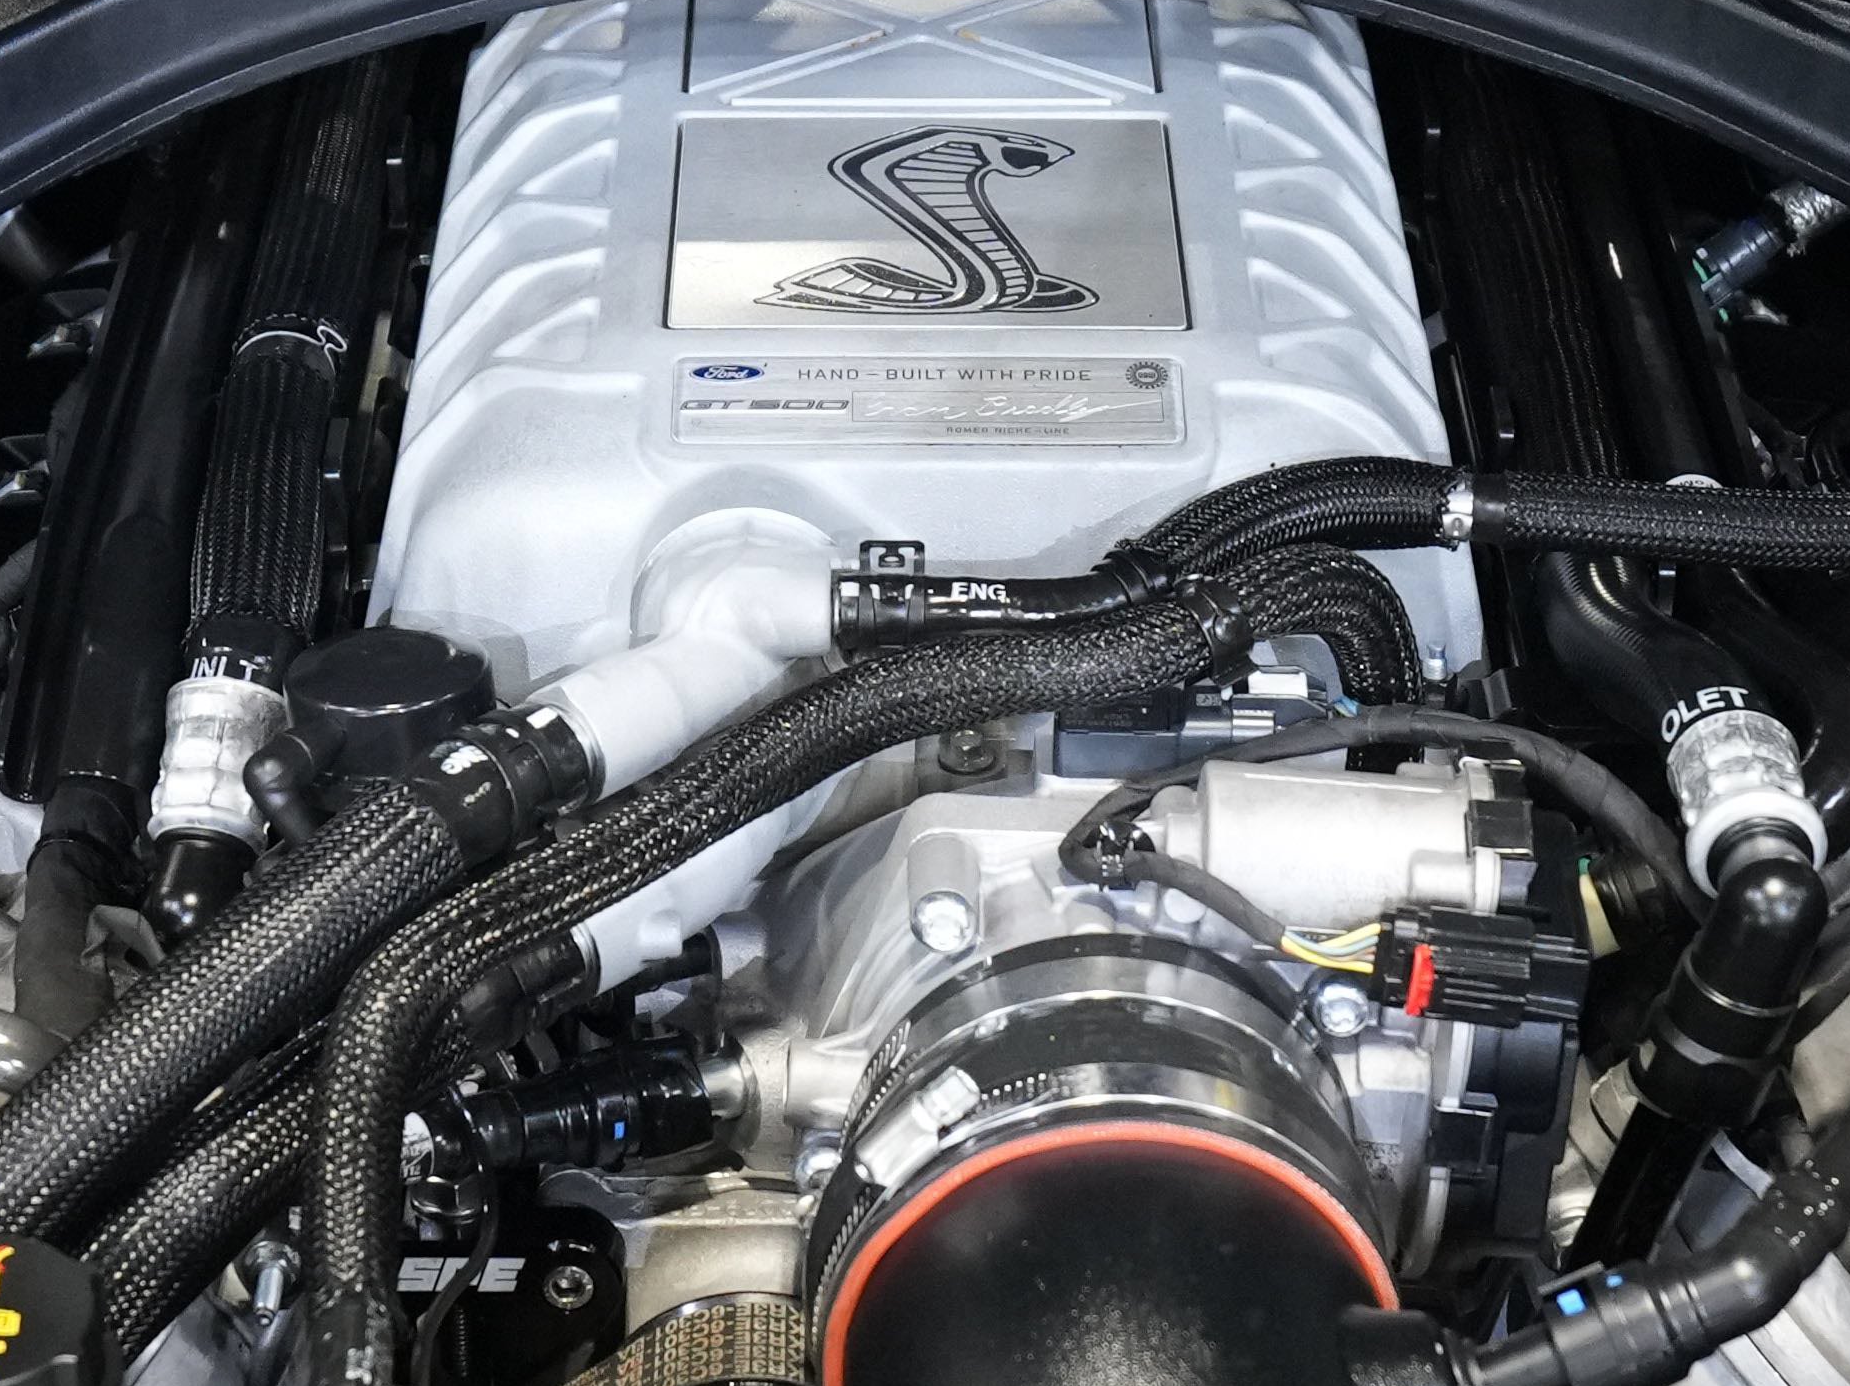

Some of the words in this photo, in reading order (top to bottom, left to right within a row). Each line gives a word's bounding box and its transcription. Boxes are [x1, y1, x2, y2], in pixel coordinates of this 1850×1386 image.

[957, 369, 1013, 381] WITH
[1023, 369, 1092, 381] PRIDE
[951, 581, 1007, 603] ENG
[1661, 686, 1749, 743] OLET
